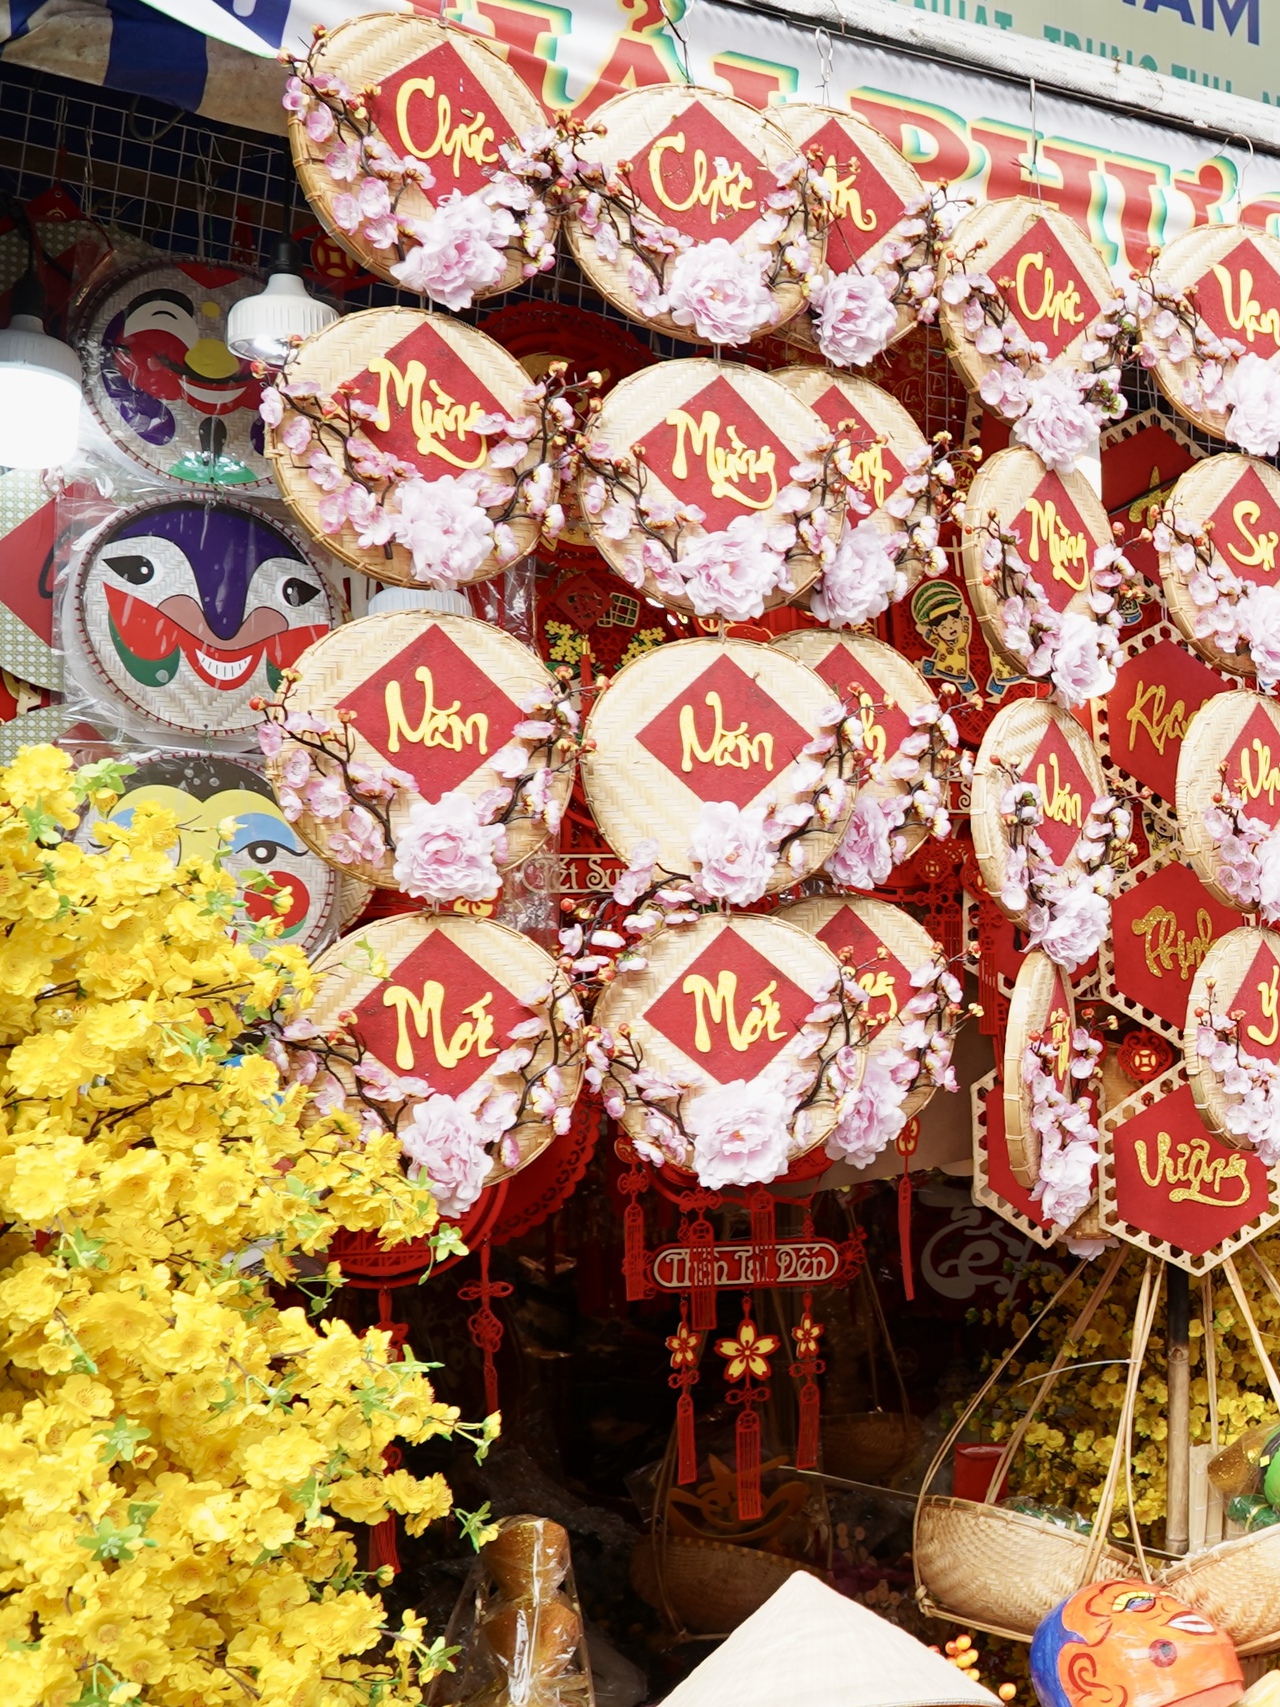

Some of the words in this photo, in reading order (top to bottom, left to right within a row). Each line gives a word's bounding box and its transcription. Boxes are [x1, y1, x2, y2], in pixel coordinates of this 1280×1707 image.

[396, 75, 499, 178] Chúc
[648, 132, 757, 225] Chúc
[1016, 251, 1085, 337] Chúc
[368, 357, 489, 470] Mừng
[666, 409, 778, 510] Mừng
[1025, 497, 1089, 591] Mừng
[384, 666, 489, 755] Năm
[679, 691, 774, 772] Năm
[1036, 752, 1083, 828] Năm
[383, 980, 500, 1070] Mới
[682, 970, 788, 1053] Mới
[1247, 965, 1279, 1047] Ý
[1133, 1130, 1252, 1207] Vượng
[777, 1246, 829, 1282] Đến
